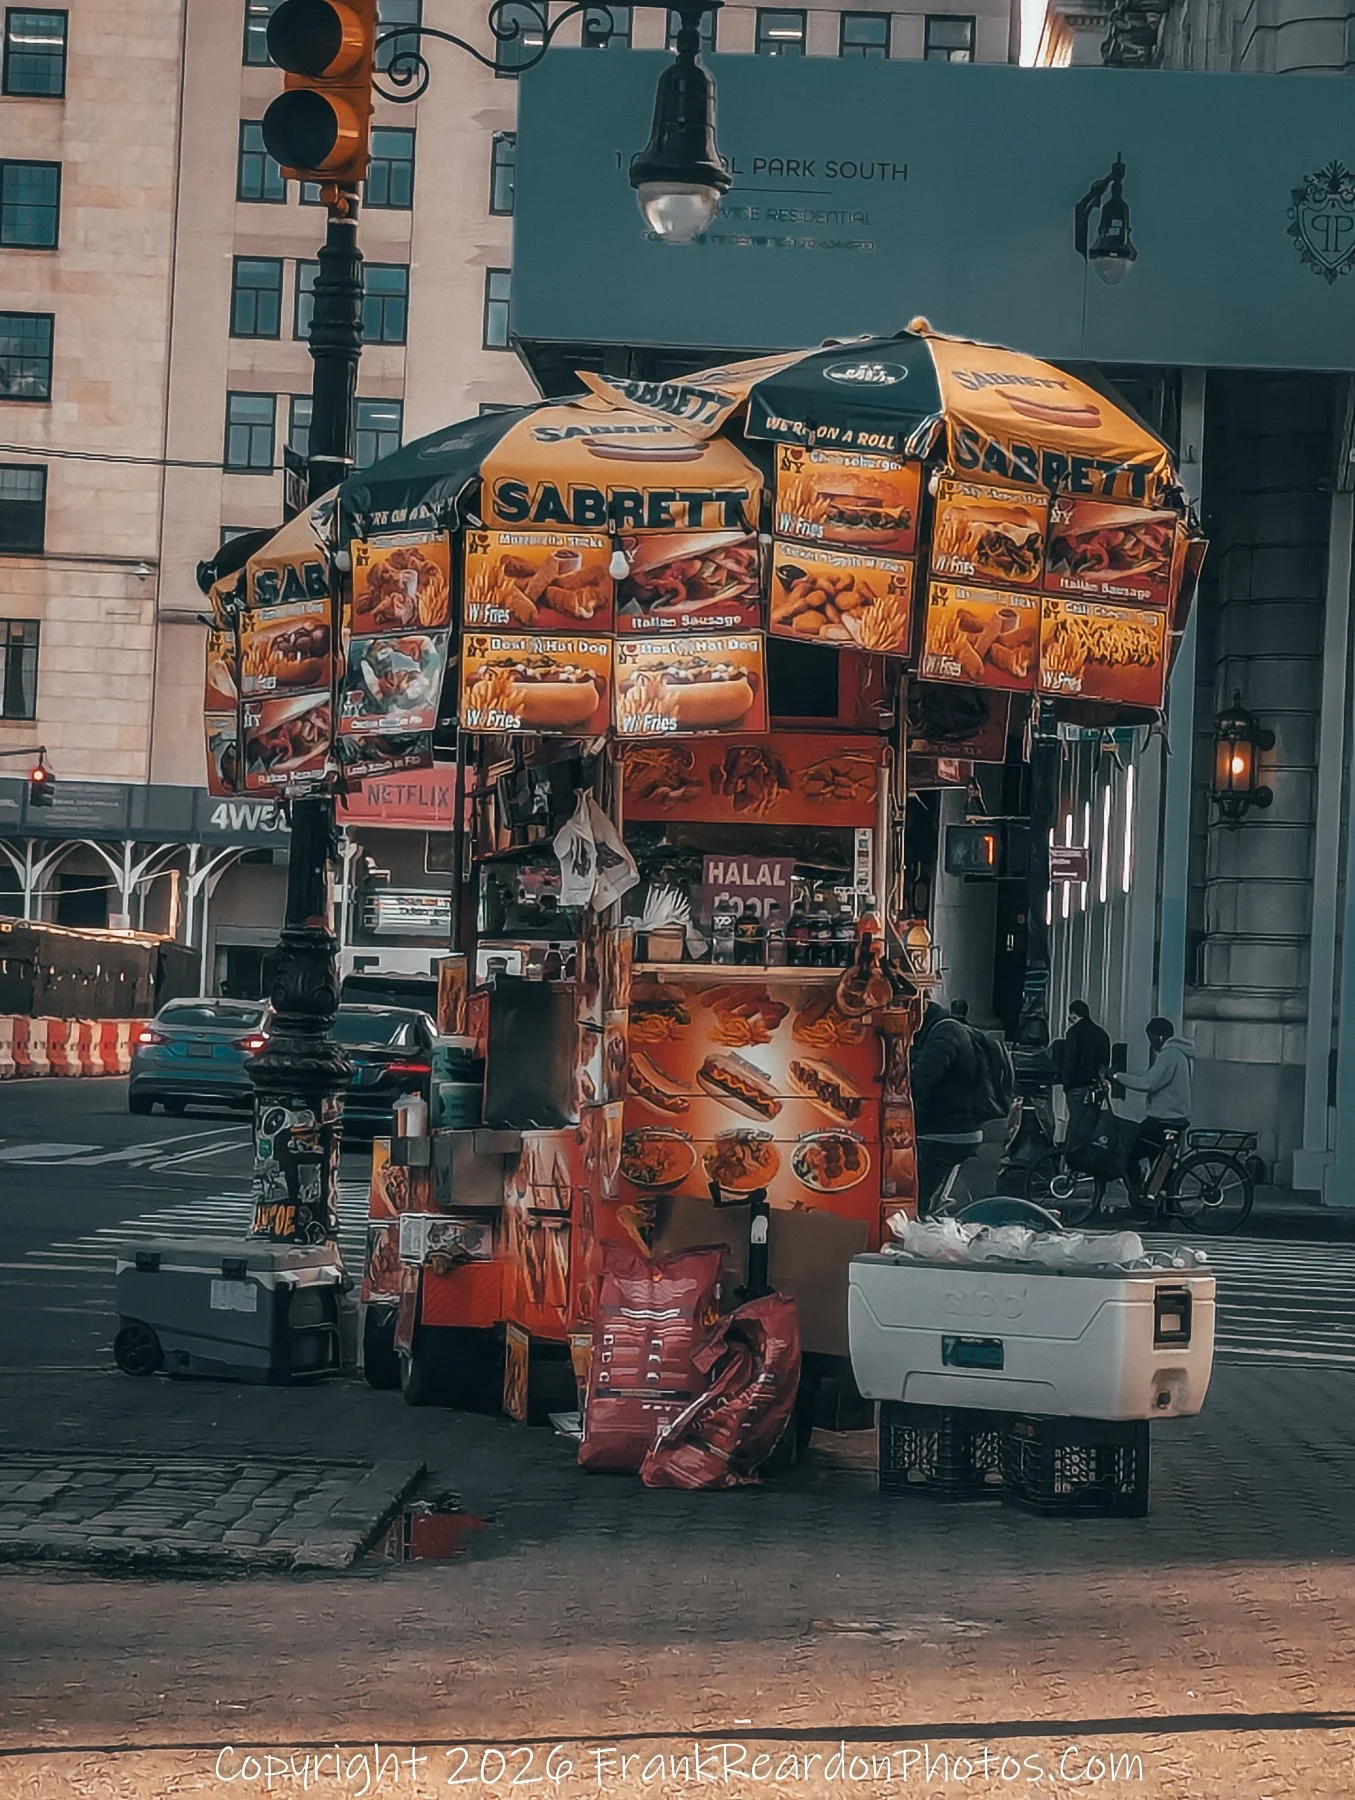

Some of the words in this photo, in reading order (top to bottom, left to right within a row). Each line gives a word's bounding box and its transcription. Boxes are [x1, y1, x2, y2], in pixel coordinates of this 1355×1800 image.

[752, 157, 817, 179] PARK
[823, 160, 909, 182] SOUTH
[952, 370, 1070, 391] SABRETT
[530, 424, 678, 443] SABRET
[816, 425, 841, 440] ON
[841, 429, 854, 443] A
[856, 431, 895, 450] ROLL
[954, 426, 1156, 499] SABRETT
[492, 476, 750, 529] SABRETT
[483, 603, 511, 624] Fries
[546, 639, 575, 653] Hot
[578, 640, 608, 656] Dog
[695, 639, 723, 653] Hot
[727, 638, 759, 652] Dog
[486, 708, 522, 729] Fries
[643, 713, 679, 732] Fries
[367, 783, 451, 808] NETFLIX
[708, 861, 787, 887] HALAL
